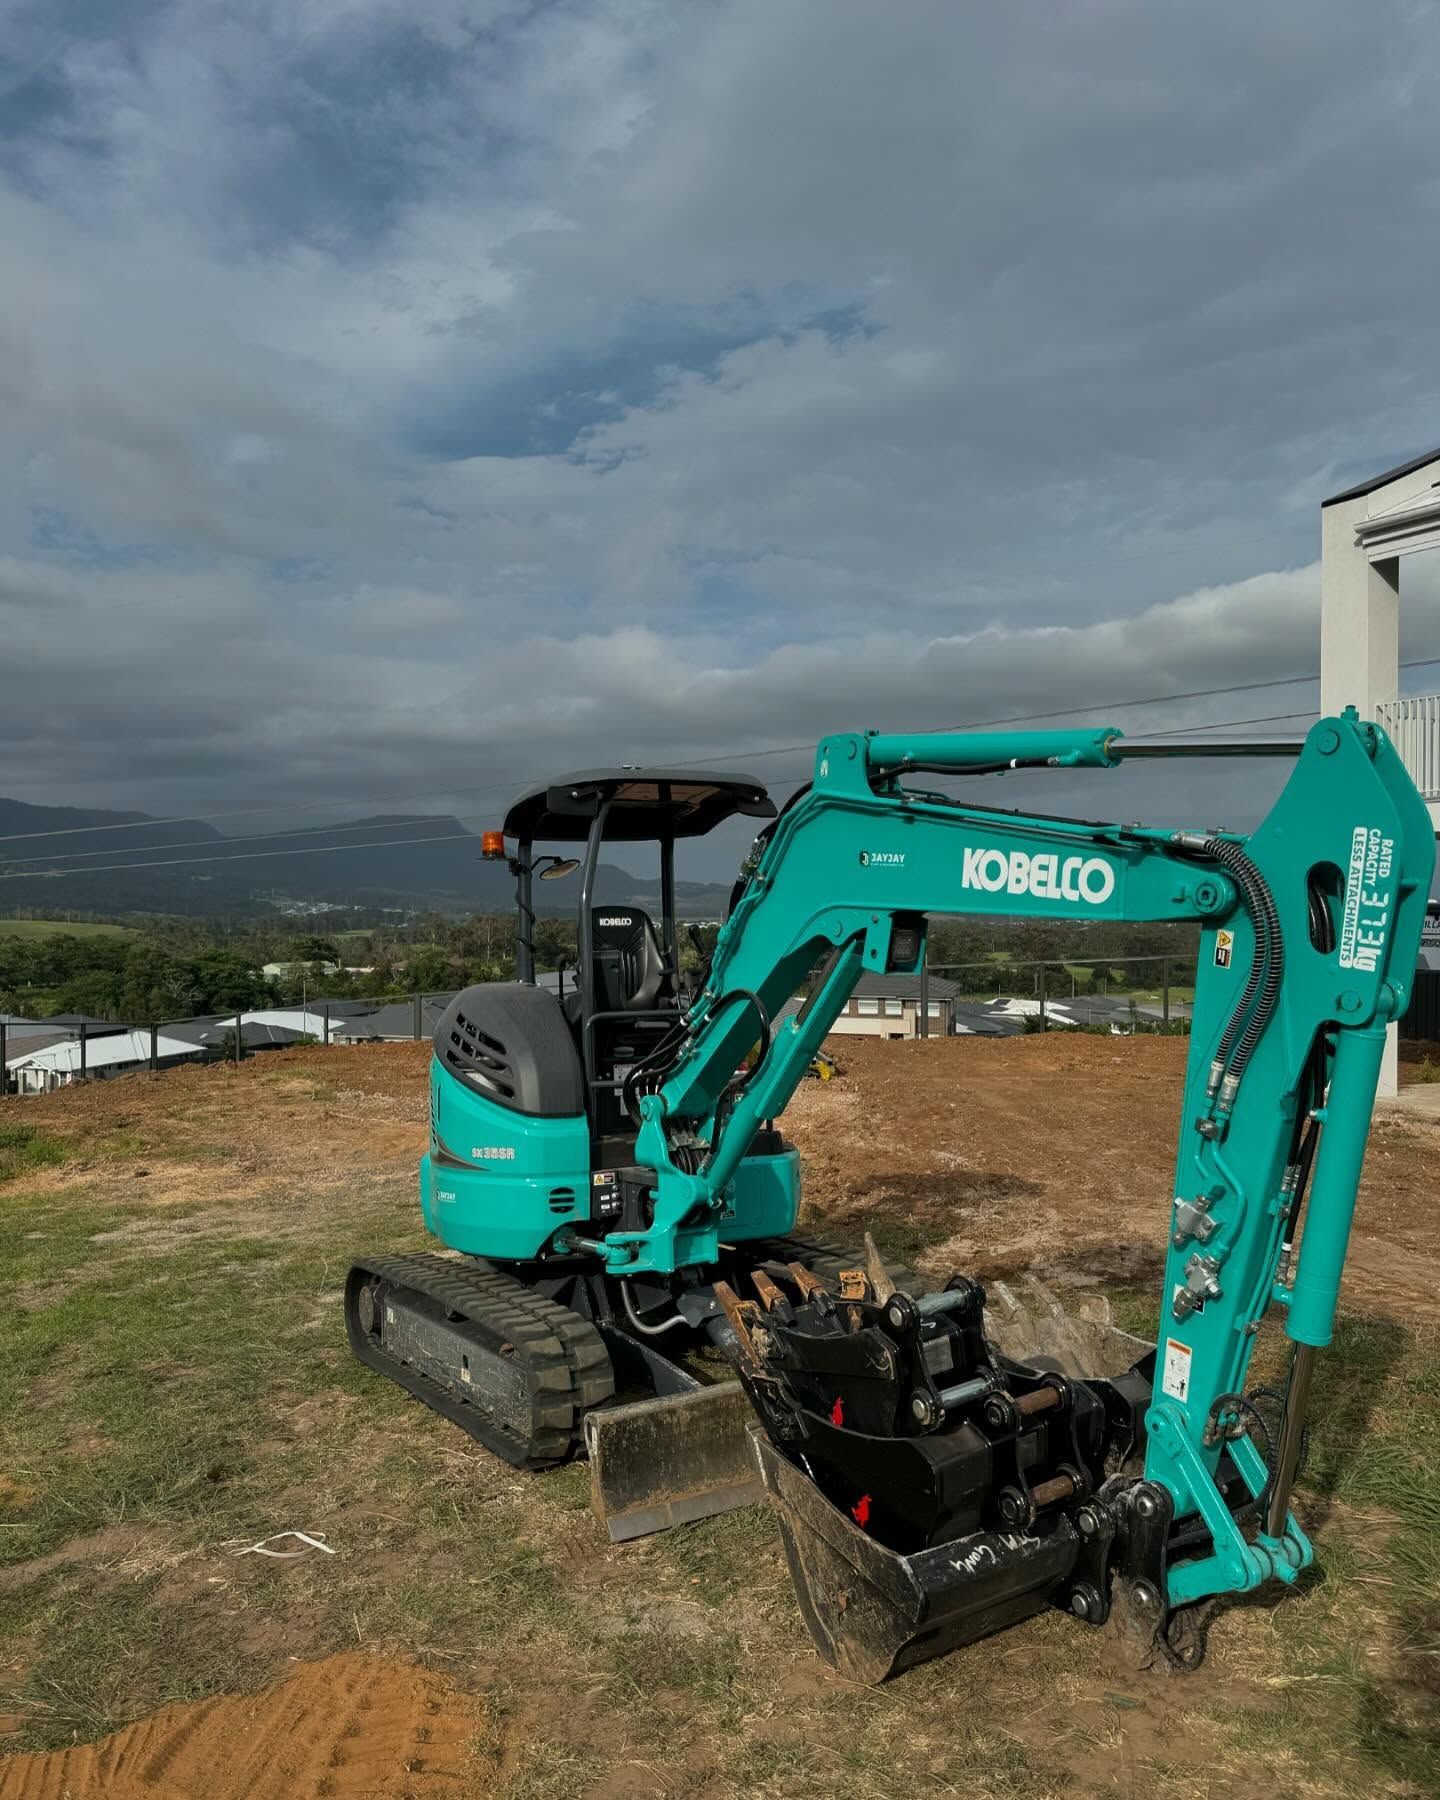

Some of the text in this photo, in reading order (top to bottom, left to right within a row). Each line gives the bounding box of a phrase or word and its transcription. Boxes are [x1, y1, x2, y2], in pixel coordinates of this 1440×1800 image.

[871, 852, 905, 863] JAYJAY
[961, 847, 1115, 904] KOBELCO
[1364, 828, 1381, 887] CAPACITY
[1378, 838, 1393, 878] RATED
[1341, 832, 1365, 962] LESS ATTACHMENTS
[599, 917, 633, 926] KOBELCO
